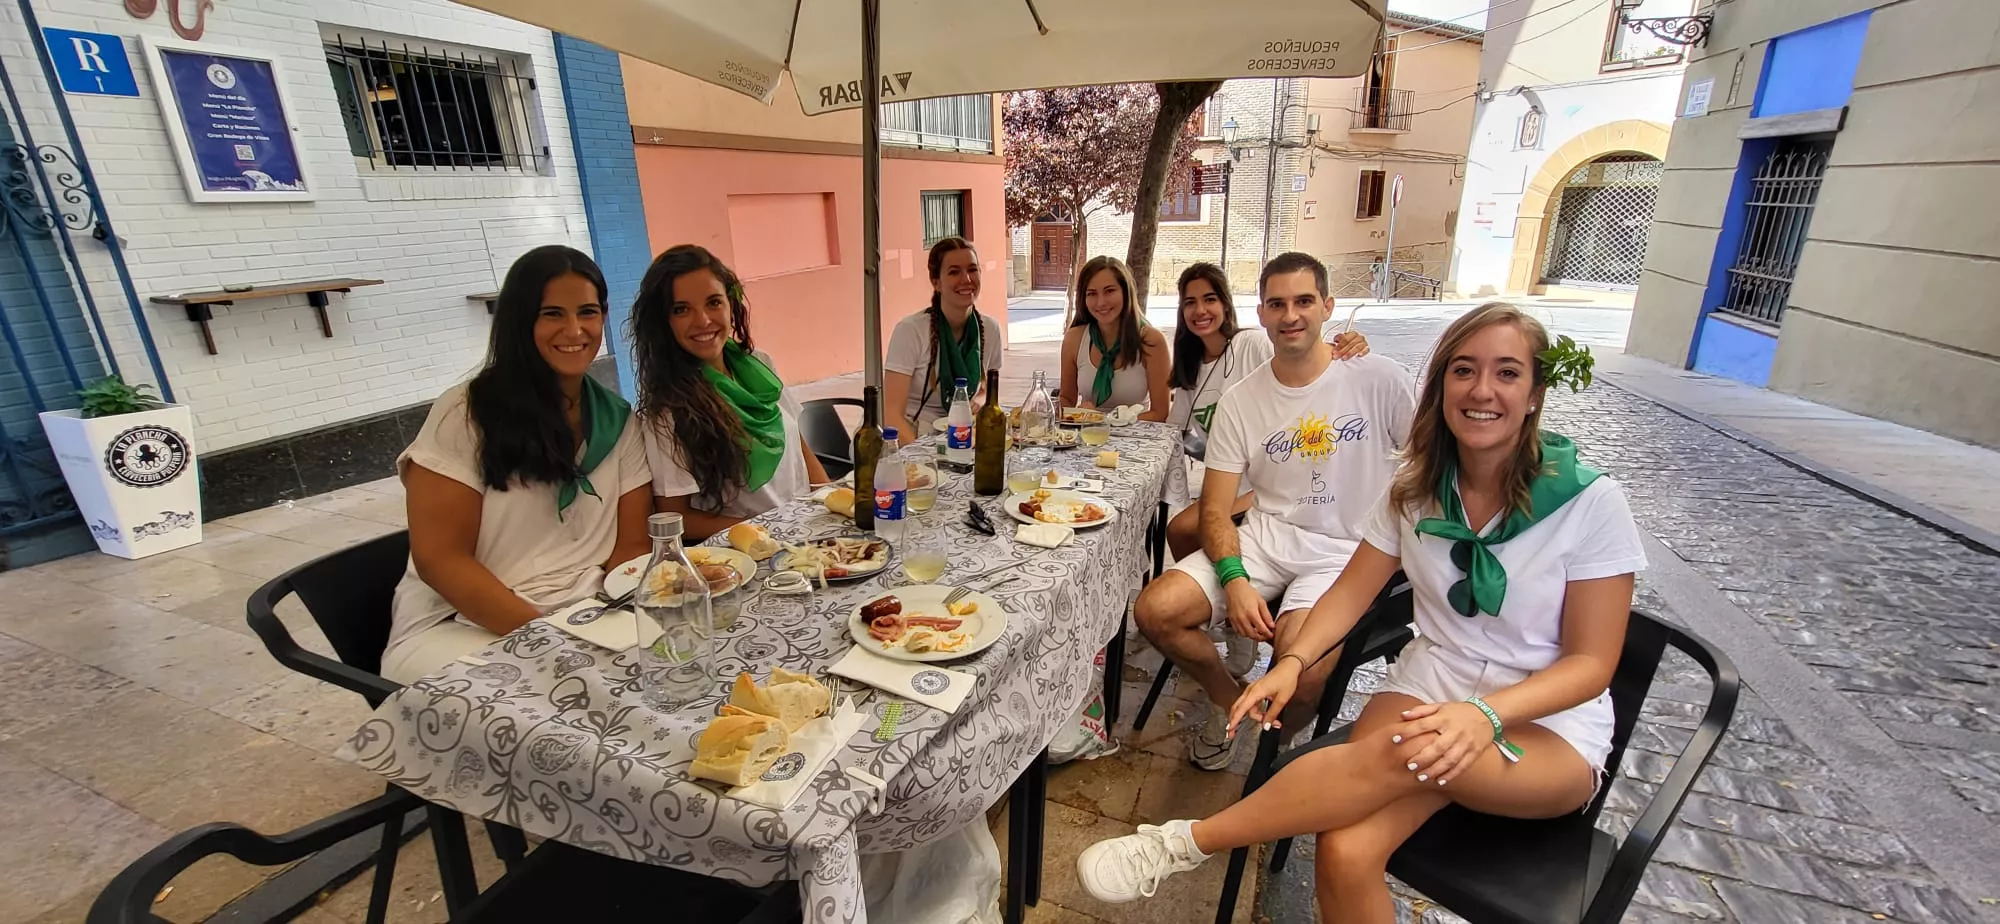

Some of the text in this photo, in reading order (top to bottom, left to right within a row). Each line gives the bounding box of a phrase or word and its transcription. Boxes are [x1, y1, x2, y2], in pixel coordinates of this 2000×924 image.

[68, 37, 110, 73] R
[116, 430, 168, 453] LA PLANCHA
[1261, 429, 1305, 464] Café
[1308, 430, 1323, 445] del
